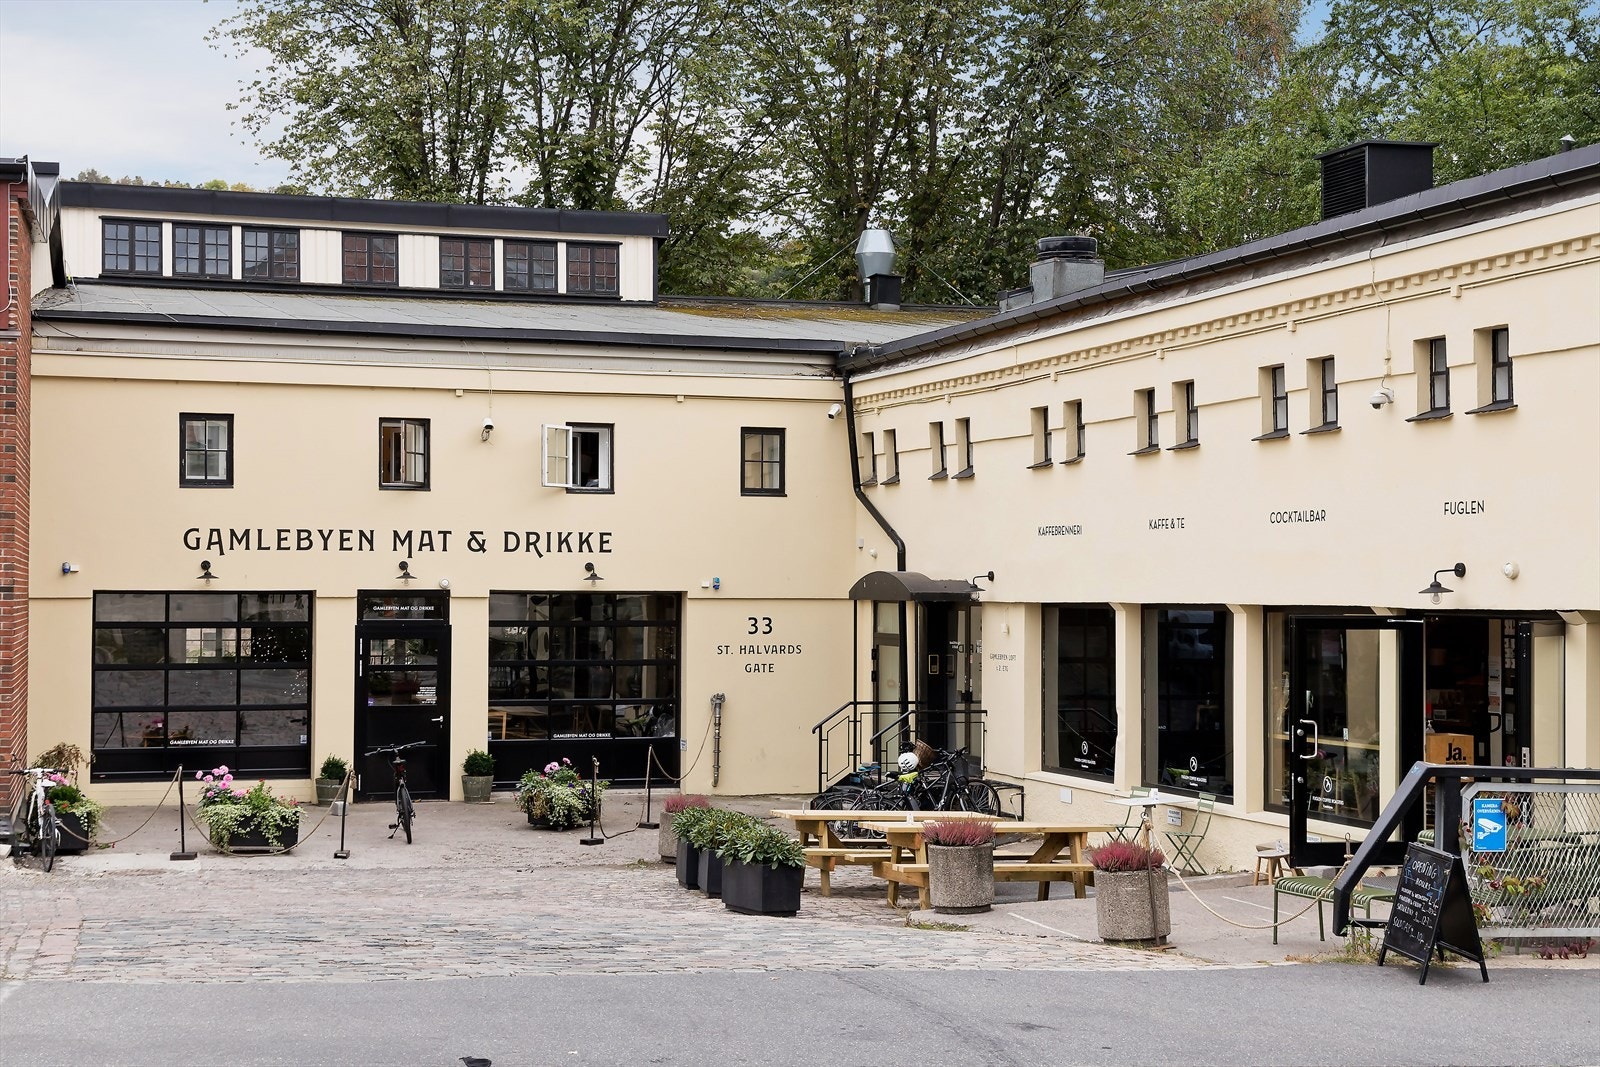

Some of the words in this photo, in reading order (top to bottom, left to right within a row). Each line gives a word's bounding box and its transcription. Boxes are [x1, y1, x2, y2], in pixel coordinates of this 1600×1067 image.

[1443, 500, 1485, 515] FUGLEN
[1149, 518, 1169, 530] KAFFE
[1170, 518, 1175, 529] &
[1176, 517, 1185, 529] TE
[1269, 509, 1327, 524] COCKTAILBAR
[1038, 525, 1083, 536] KAFFEBRENNERI
[183, 527, 375, 556] GAMLEBYEN
[392, 529, 453, 559] MAT
[466, 530, 488, 554] &
[503, 531, 613, 559] DRIKKE
[747, 616, 773, 635] 33
[717, 645, 734, 655] ST.
[739, 644, 802, 655] HALVARDS
[744, 663, 775, 673] GATE
[1446, 743, 1467, 761] Ja.
[1412, 860, 1438, 879] OPENING
